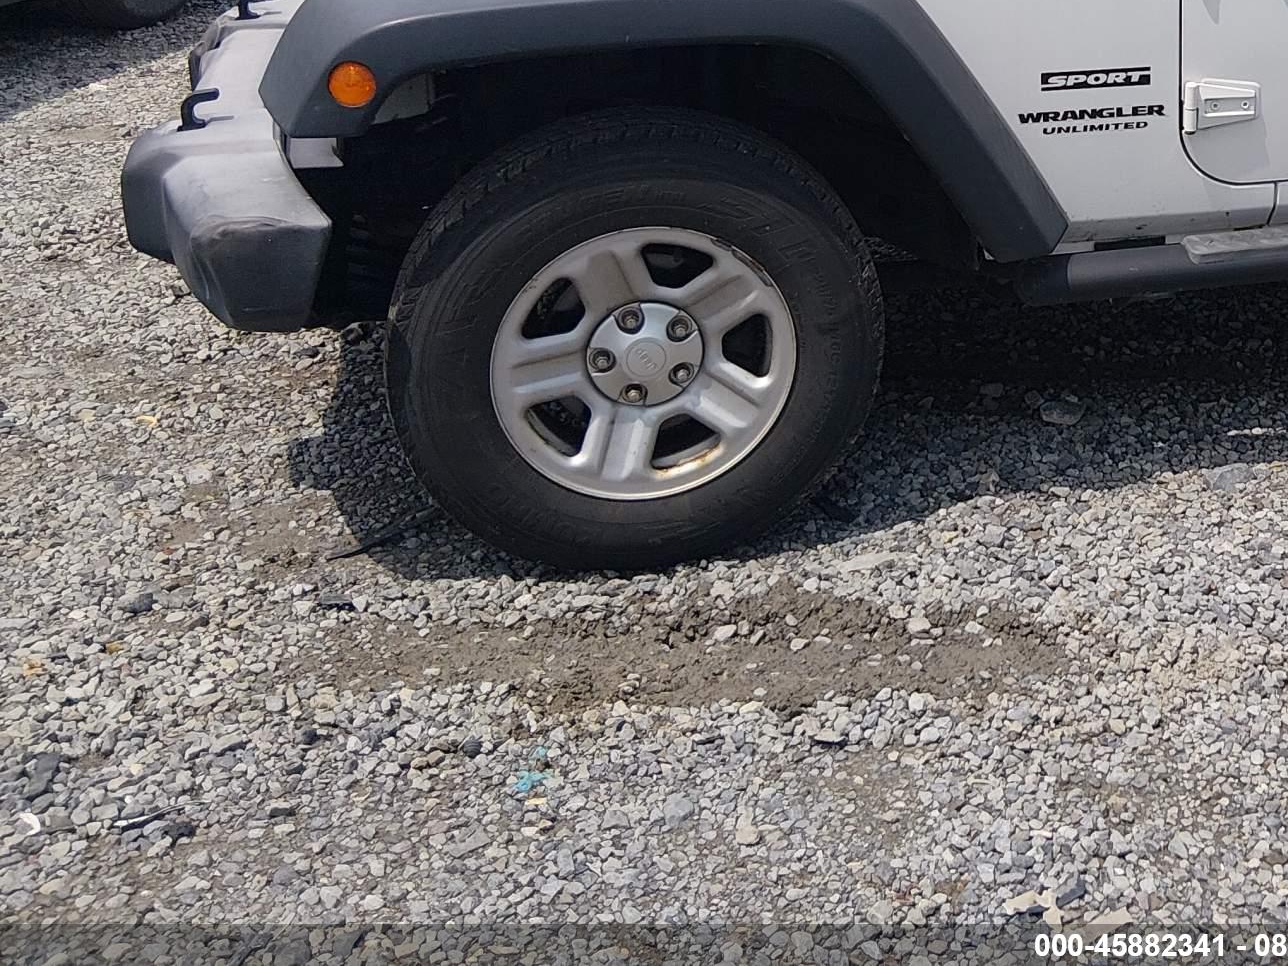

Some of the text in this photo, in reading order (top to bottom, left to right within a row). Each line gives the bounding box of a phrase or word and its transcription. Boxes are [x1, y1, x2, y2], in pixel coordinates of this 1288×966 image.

[1043, 69, 1149, 89] SPORT
[1017, 104, 1165, 124] WRANGLER
[1042, 121, 1149, 135] UNLIMITED
